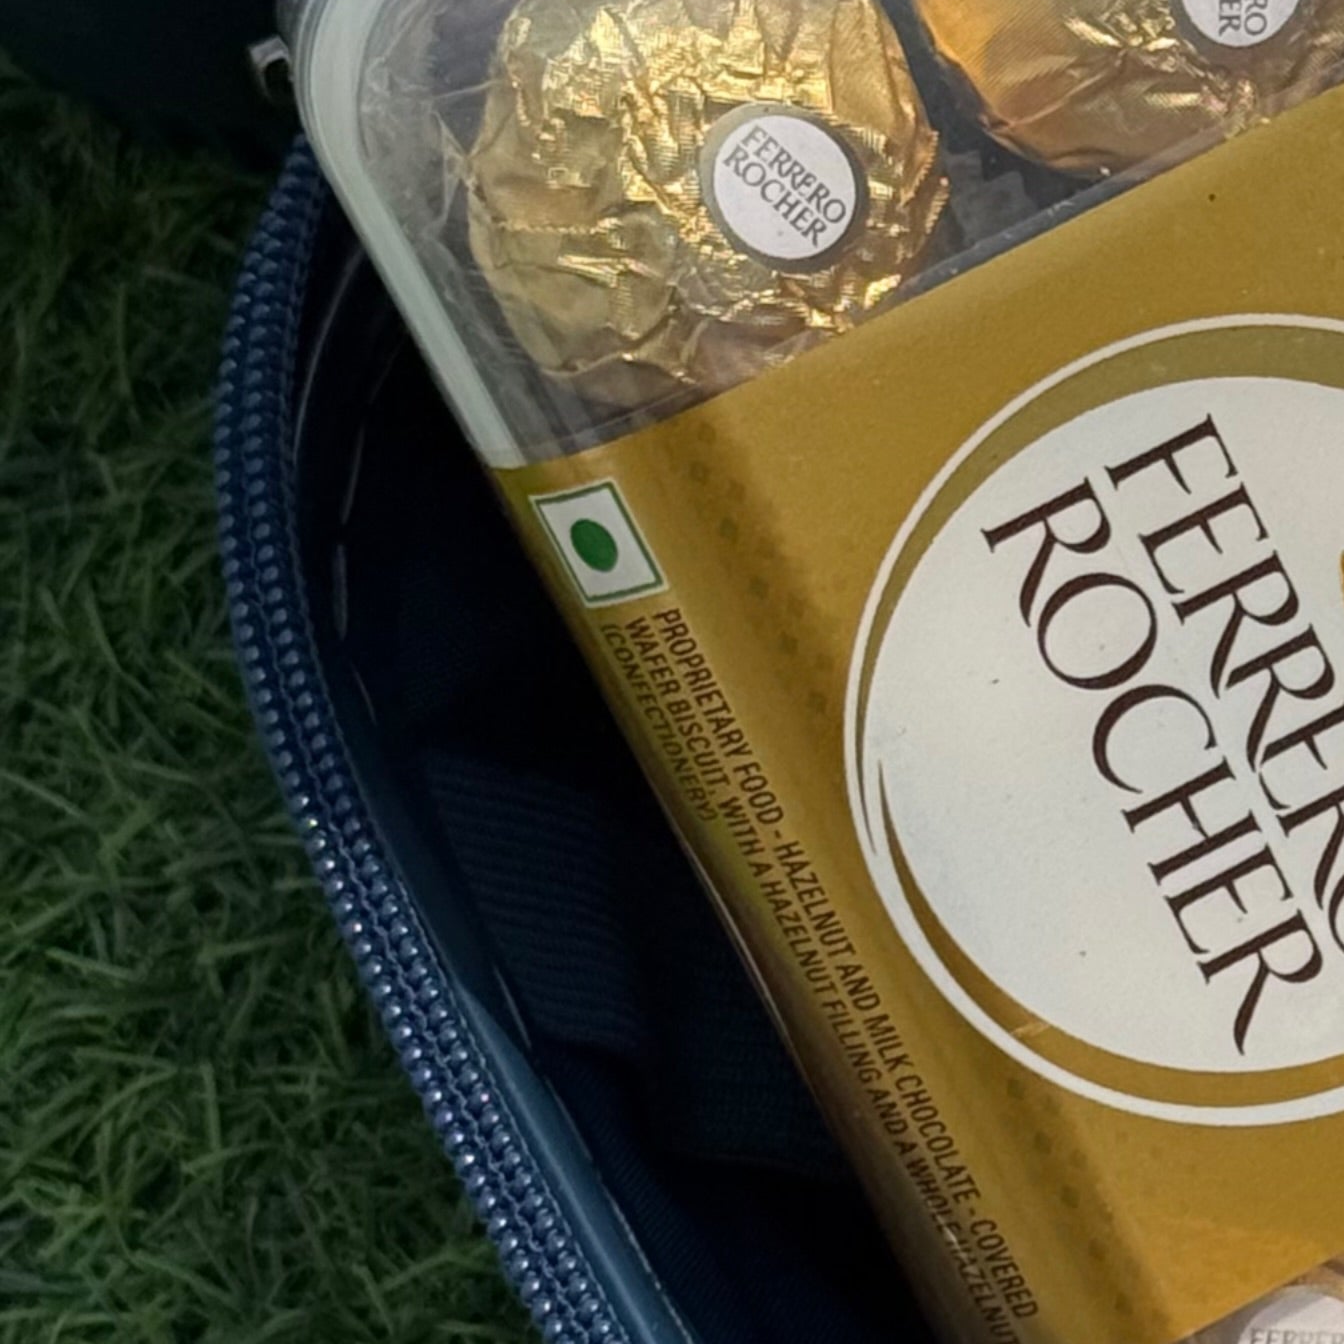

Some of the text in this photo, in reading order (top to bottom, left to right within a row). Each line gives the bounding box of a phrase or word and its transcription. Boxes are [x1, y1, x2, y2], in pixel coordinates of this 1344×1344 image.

[723, 147, 829, 247] ROCHER
[740, 124, 847, 229] FERRERO
[622, 615, 682, 699] WAFER
[597, 620, 719, 825] (CONFECTIONERY)
[661, 695, 733, 798] BISCUIT,
[980, 477, 1327, 1055] ROCHER
[716, 795, 766, 860] WITH
[747, 853, 775, 879] A
[650, 604, 754, 764] PROPRIETARY
[731, 758, 786, 830] FOOD
[771, 837, 856, 965] HAZELNUT
[834, 957, 882, 1016] AND
[860, 1008, 913, 1075] MILK
[891, 1069, 982, 1208] CHOCOLATE
[967, 1214, 1041, 1322] COVERED
[758, 874, 839, 1000] HAZELNUT
[820, 995, 884, 1086] FILLING
[865, 1082, 910, 1139] AND
[893, 1133, 919, 1158] A
[903, 1154, 960, 1236] WHOLE
